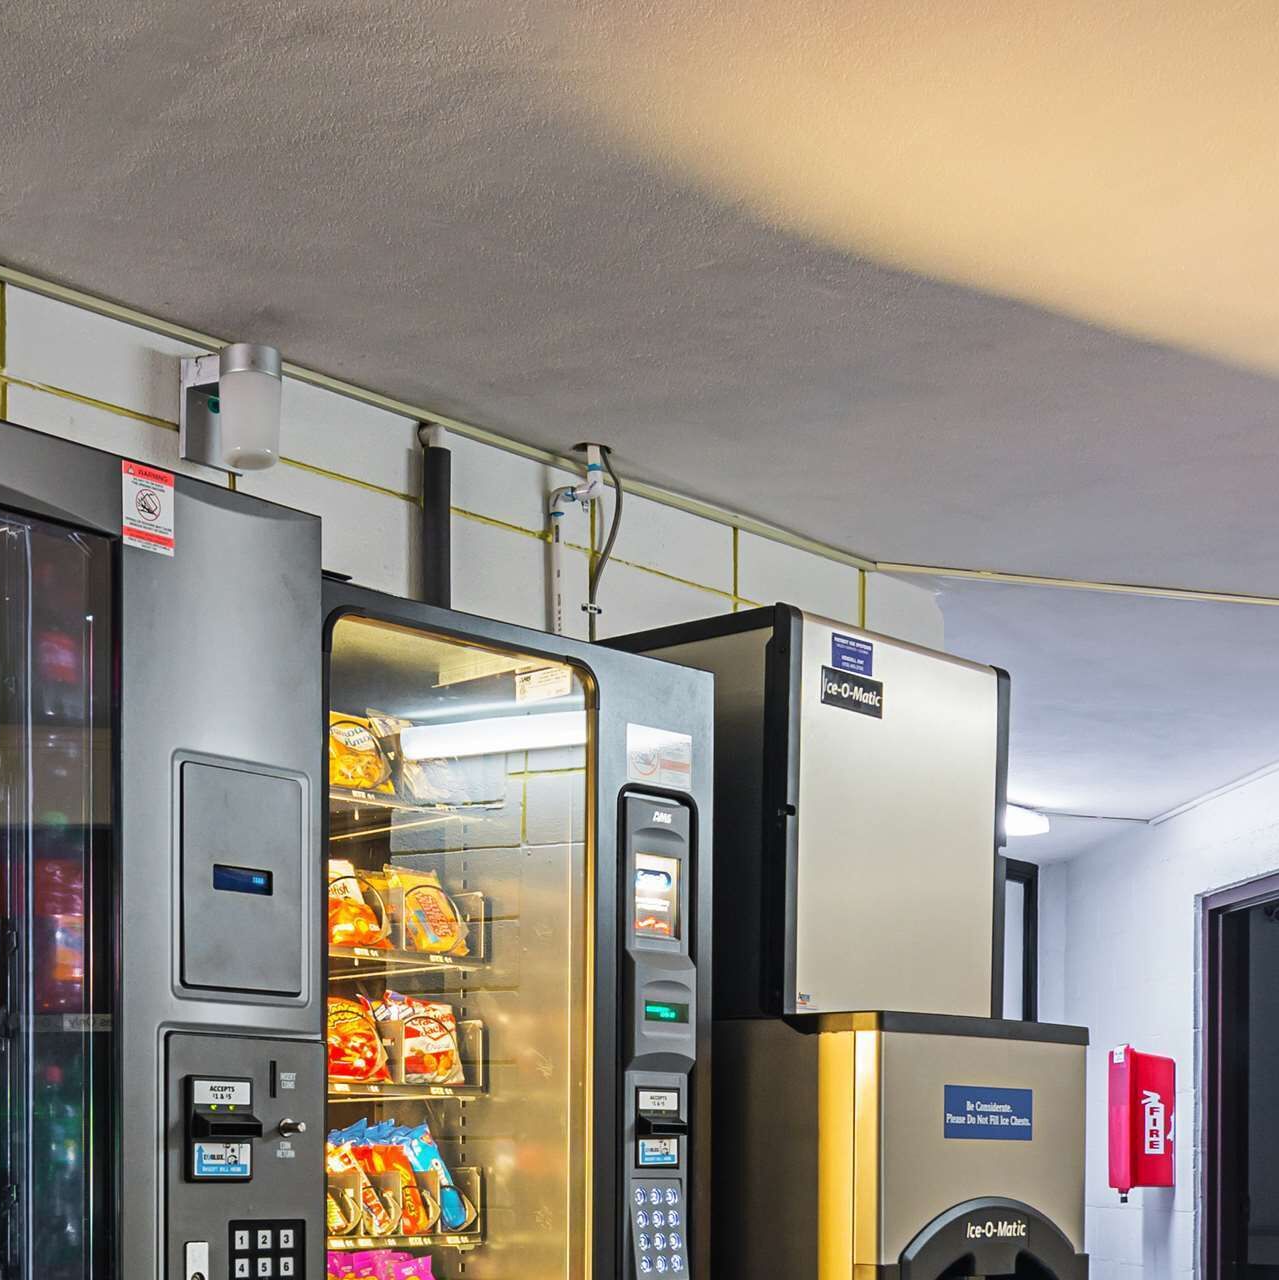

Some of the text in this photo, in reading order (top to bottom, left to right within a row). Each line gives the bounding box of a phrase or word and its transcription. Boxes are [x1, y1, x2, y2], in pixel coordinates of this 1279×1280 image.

[652, 811, 672, 824] AMS
[966, 1100, 1013, 1113] Be Considerate.
[946, 1113, 1031, 1126] Please Do Not Fill Ice Chests.
[1149, 1107, 1160, 1149] FIRE
[967, 1220, 1026, 1239] Ice-O-Matic
[239, 1234, 289, 1245] 1 2 3
[238, 1262, 289, 1273] 4 5 6
